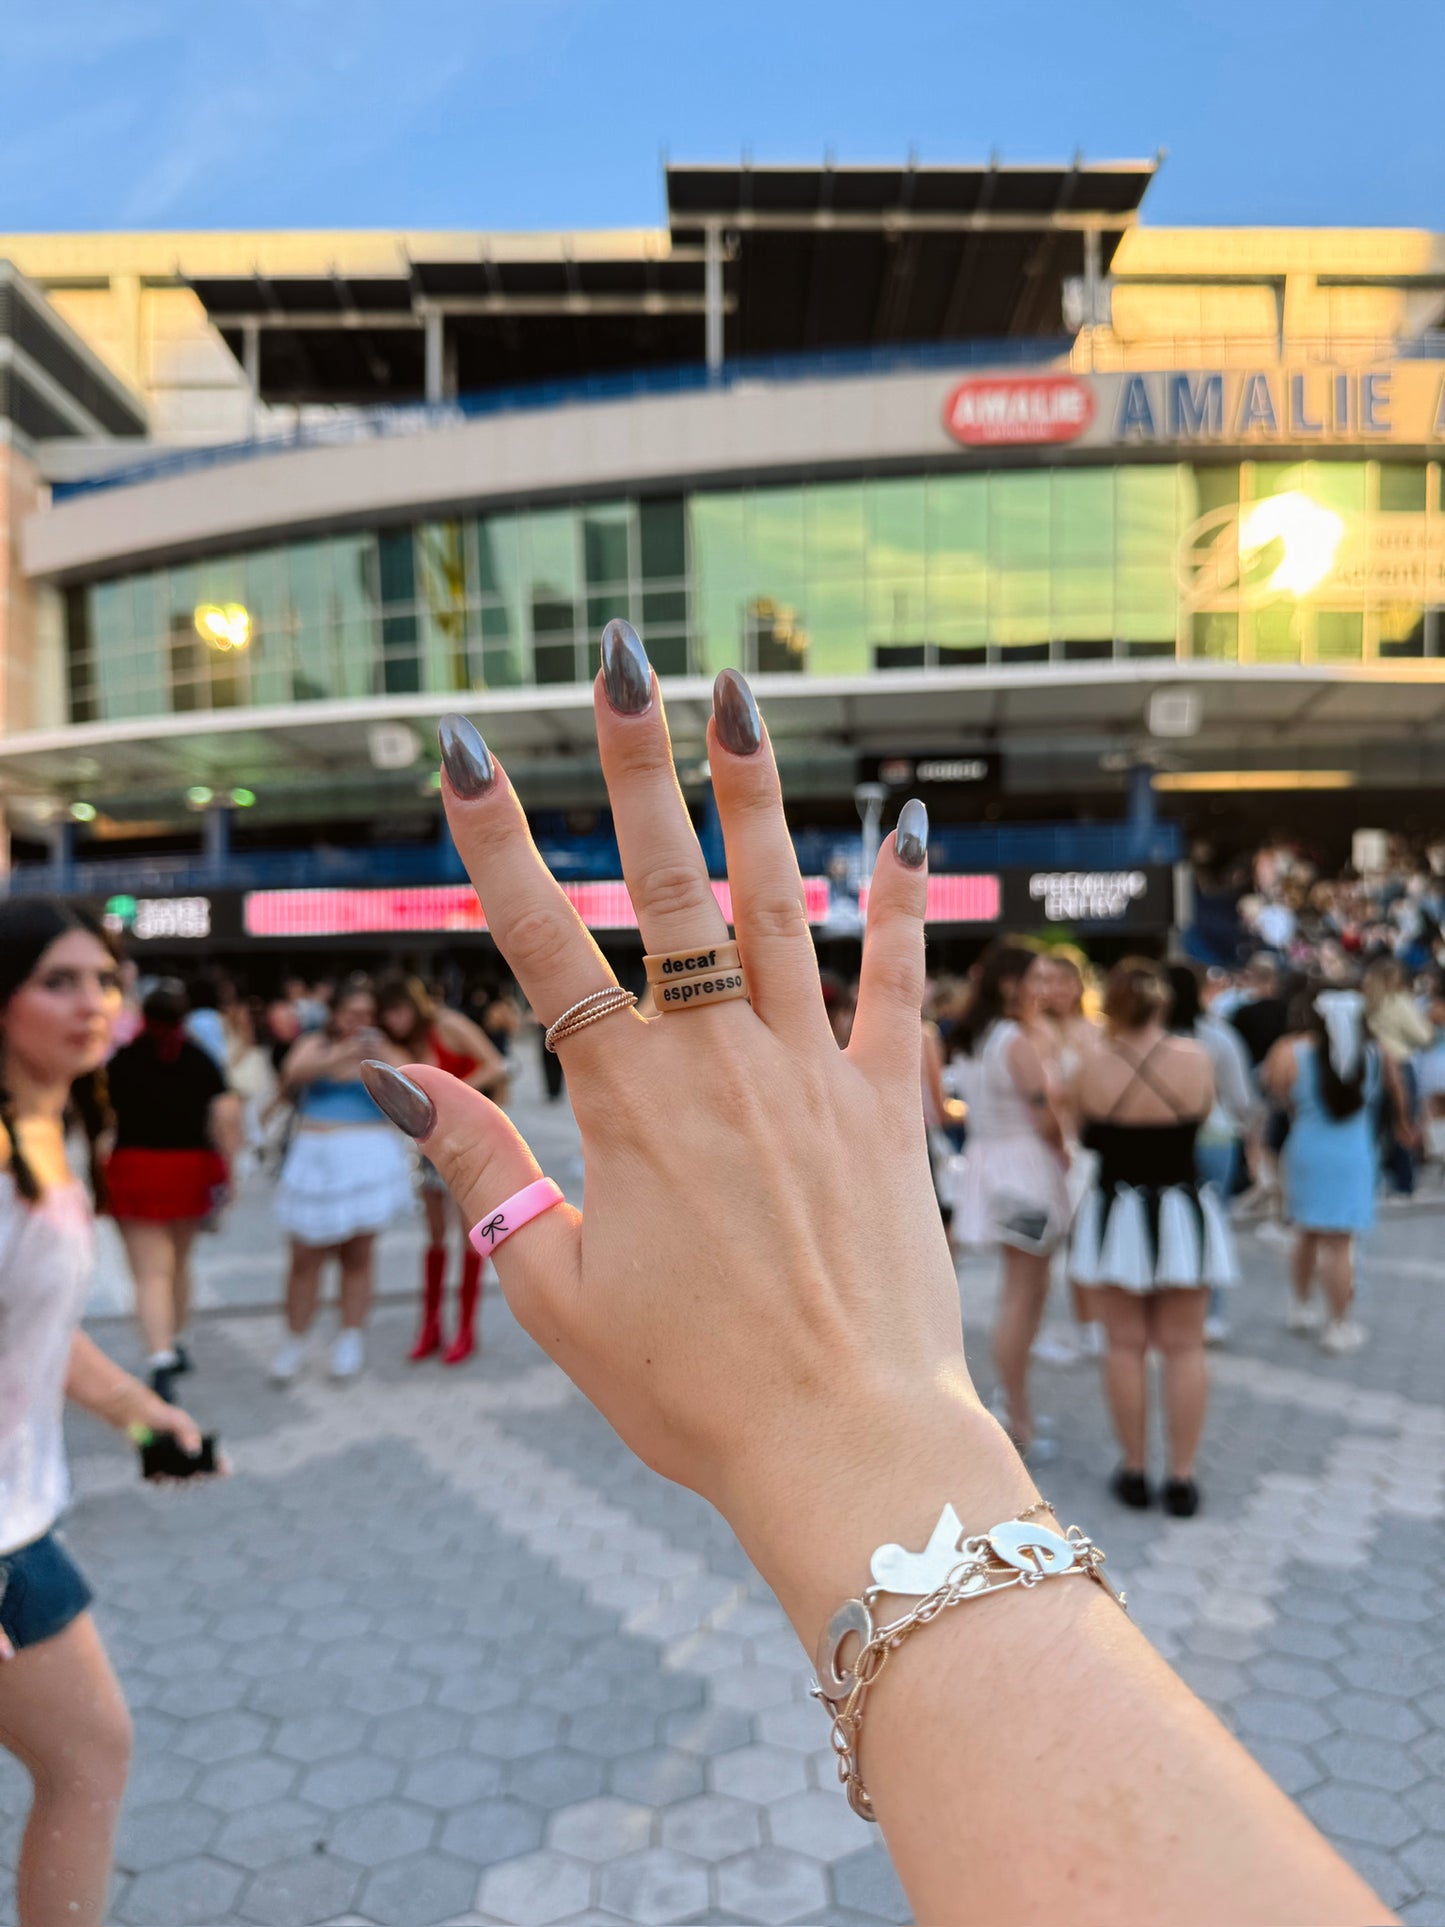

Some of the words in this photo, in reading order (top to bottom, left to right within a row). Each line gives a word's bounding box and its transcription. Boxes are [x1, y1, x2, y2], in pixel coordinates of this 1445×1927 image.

[952, 384, 1085, 424] AMALIE
[1114, 371, 1393, 438] AMALIE
[1045, 895, 1127, 920] ENTRY
[662, 950, 716, 974] decaf
[663, 975, 742, 1002] espresso
